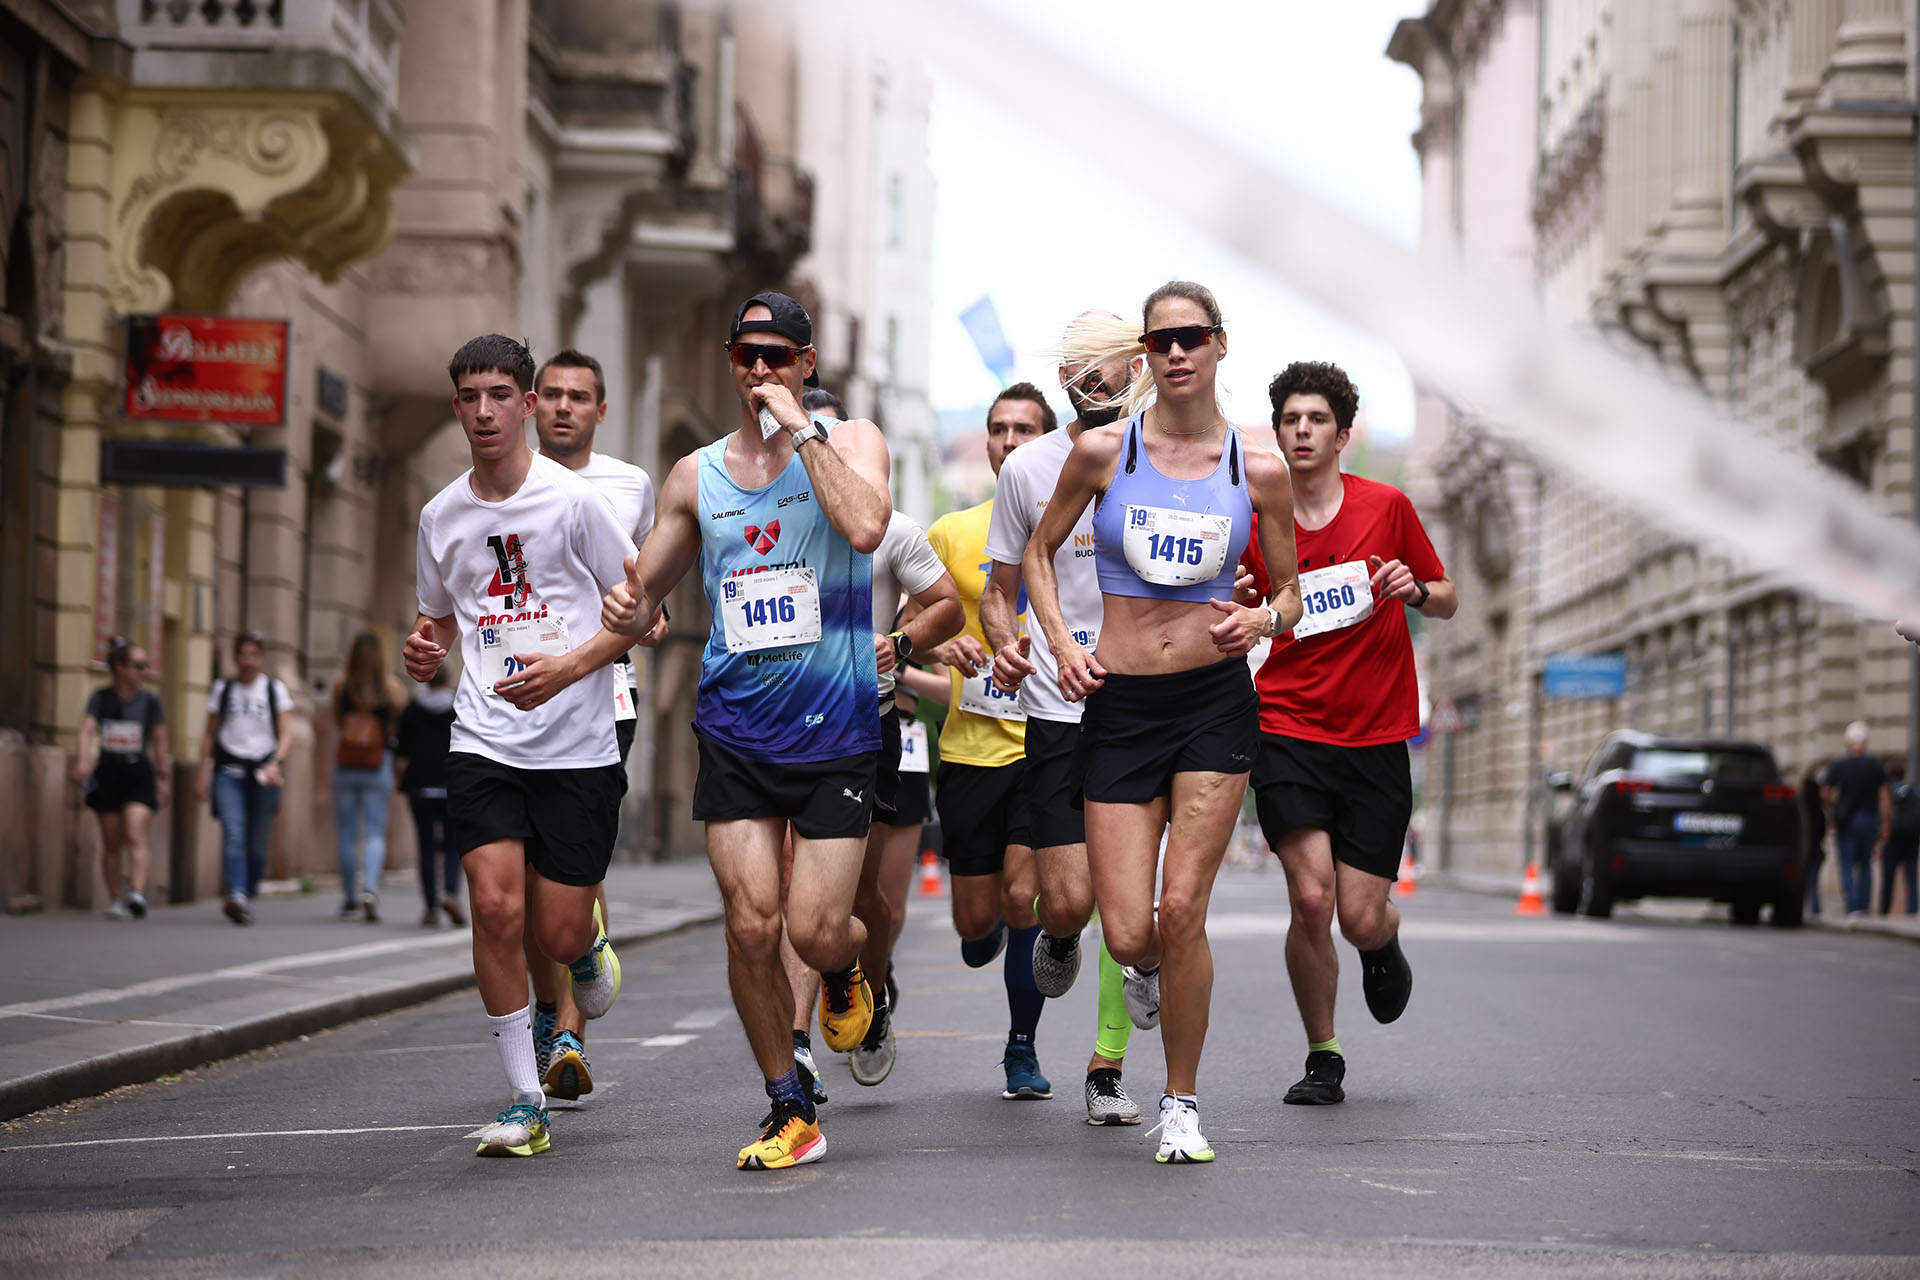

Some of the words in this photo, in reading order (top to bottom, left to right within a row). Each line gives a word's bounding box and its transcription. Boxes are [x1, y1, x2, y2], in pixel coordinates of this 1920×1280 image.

[711, 508, 745, 520] SALMING
[1130, 509, 1147, 526] 19
[1148, 533, 1203, 566] 1415
[722, 581, 736, 599] 19
[1303, 584, 1355, 615] 1360
[741, 595, 795, 628] 1416
[481, 628, 495, 645] 19
[1072, 630, 1088, 646] 19
[762, 651, 803, 663] MetLife
